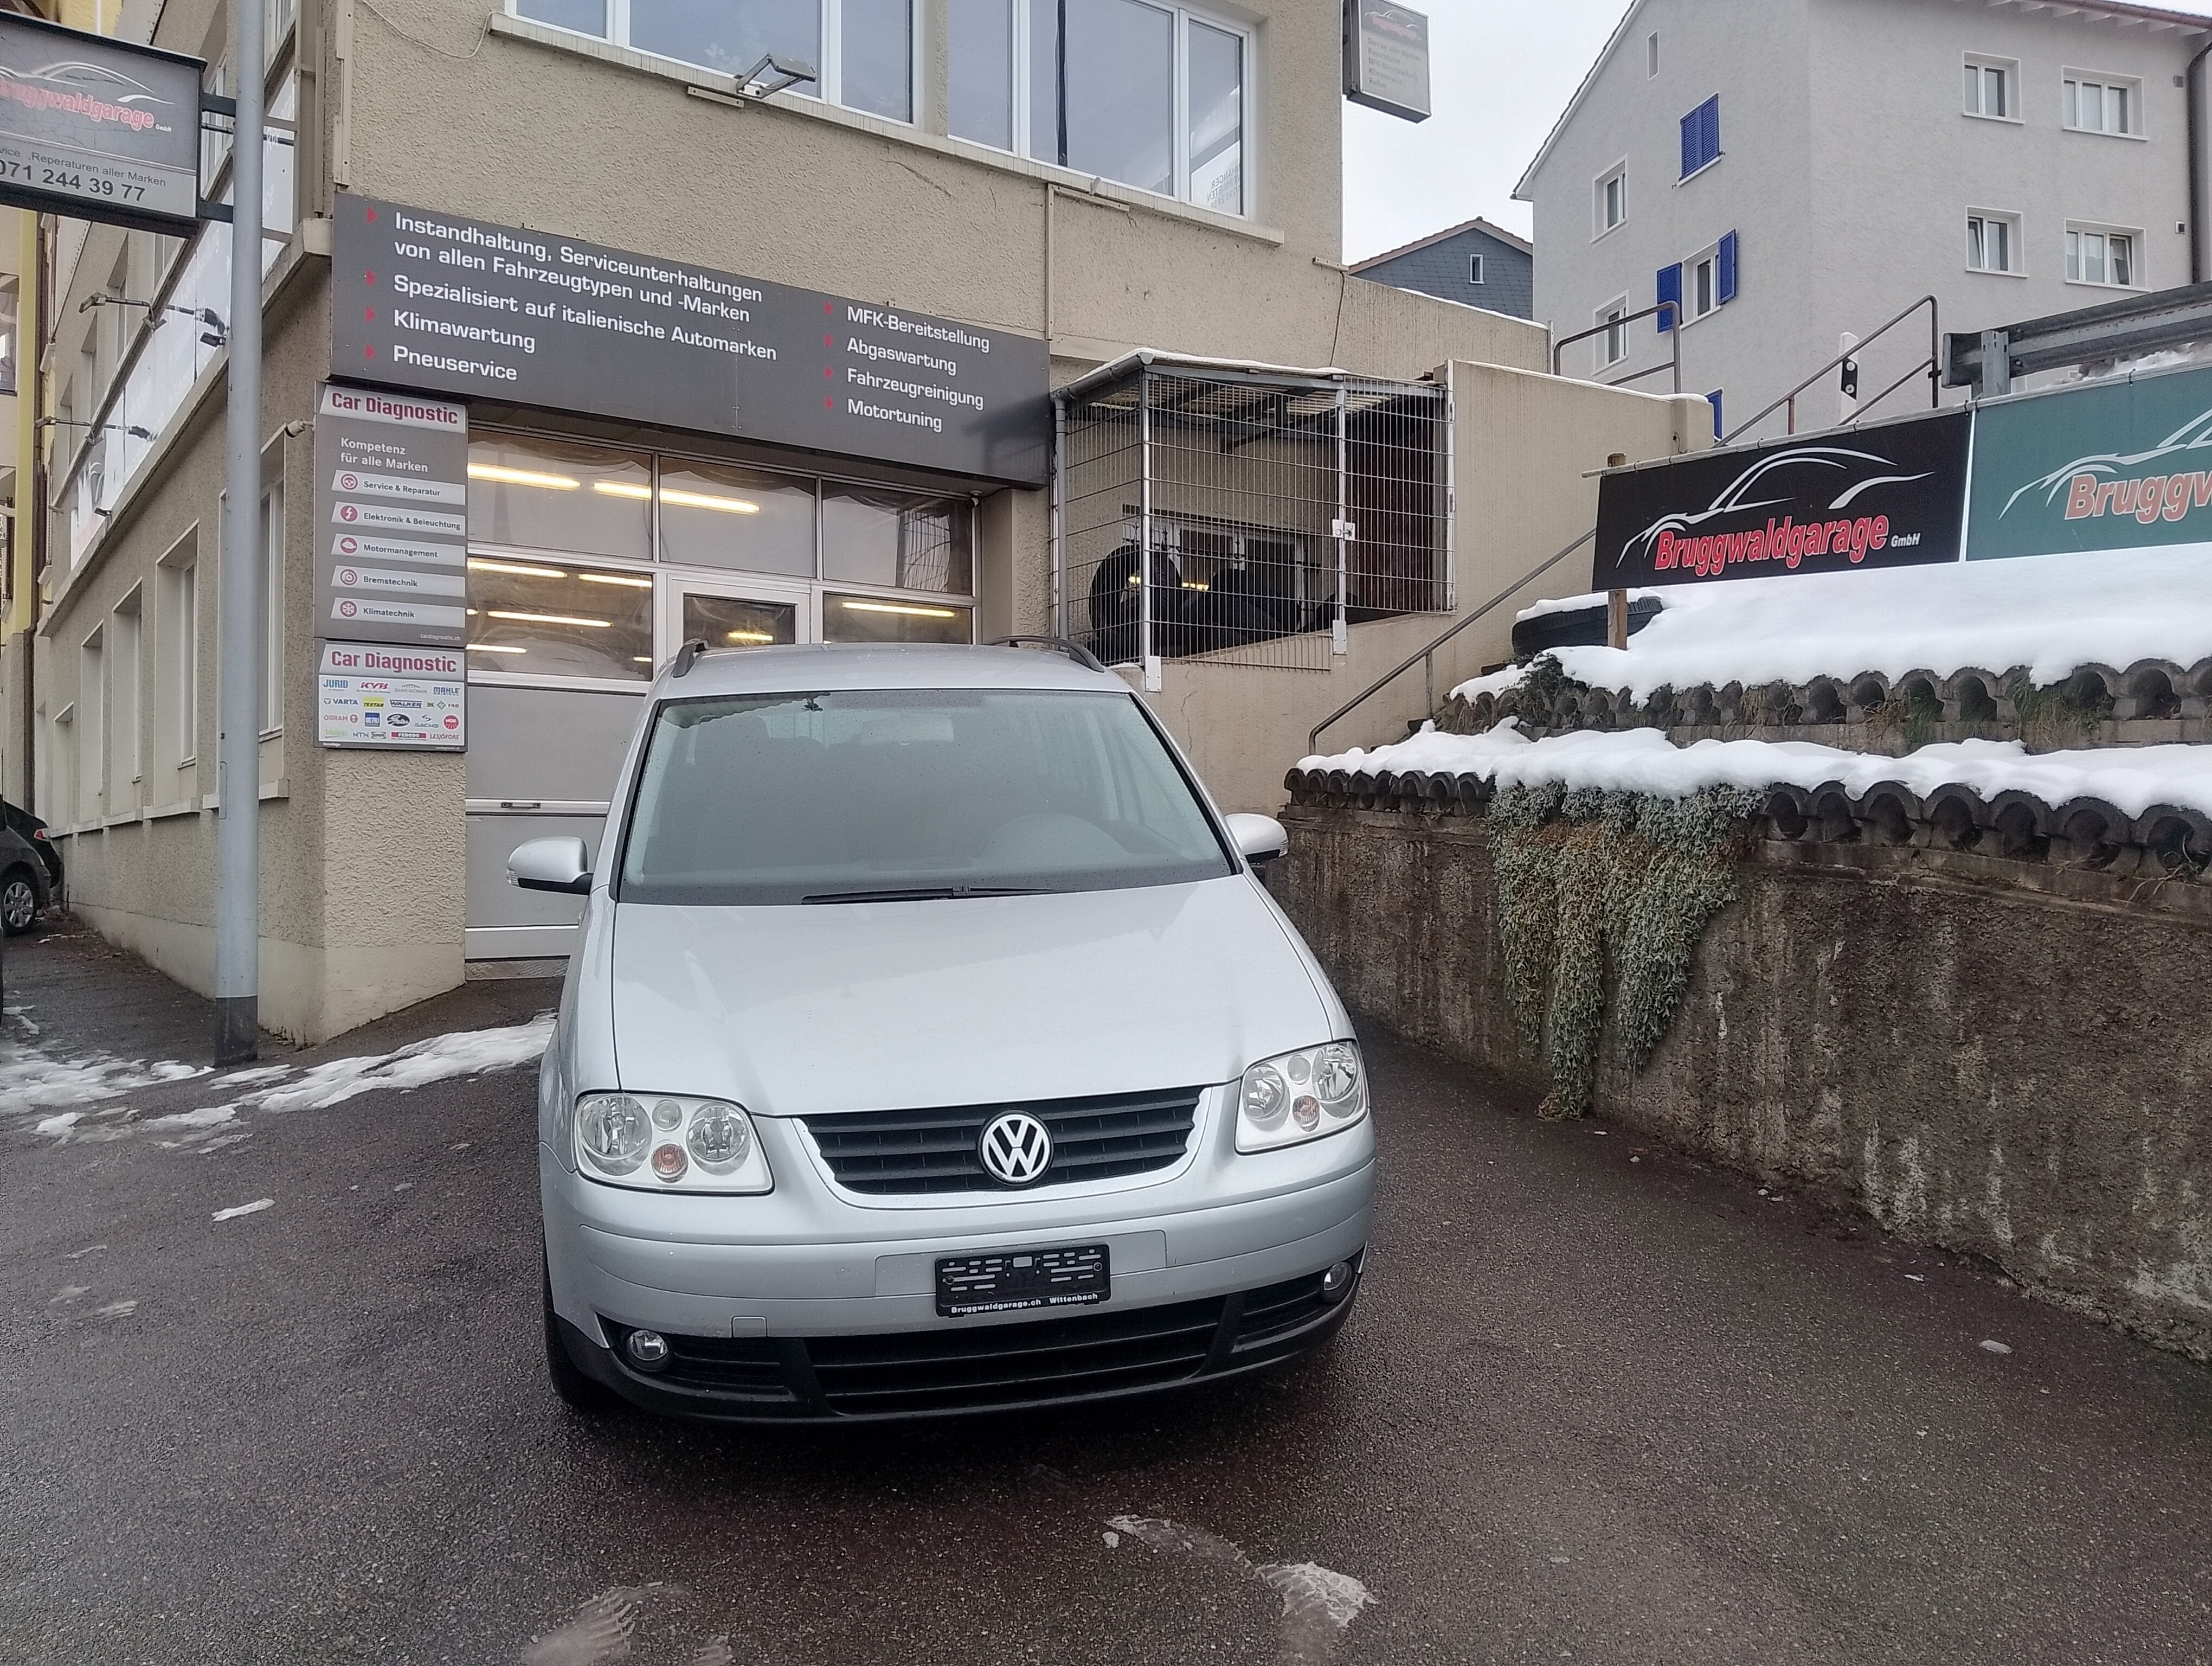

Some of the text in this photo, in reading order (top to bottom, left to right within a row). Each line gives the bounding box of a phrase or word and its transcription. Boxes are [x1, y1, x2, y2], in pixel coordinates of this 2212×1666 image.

[42, 169, 81, 190] 244
[88, 177, 113, 195] 39
[121, 183, 146, 202] 77
[102, 168, 124, 178] aller
[128, 171, 166, 187] Marken
[395, 212, 762, 303] Instandhaltung, Serviceunterhaltungen
[394, 242, 750, 323] von allen Fahrzeugtypen und -Marken
[394, 274, 777, 361] Spezialisiert auf italienische Automarken
[394, 309, 536, 354] Klimawartung
[847, 305, 990, 354] MFK-Bereitstellung
[394, 344, 517, 381] Pneuservice
[847, 337, 956, 376] Abgaswartung
[847, 368, 984, 411] Fahrzeugreinigung
[332, 392, 458, 424] Car Diagnostic
[847, 399, 942, 432] Motortuning
[340, 437, 406, 455] Kompetenz
[340, 452, 428, 473] für alle Marken
[363, 480, 393, 491] Service
[403, 485, 441, 496] Reparatur
[364, 512, 404, 523] Elektronik
[413, 518, 461, 530] Beleuchtung
[363, 544, 438, 558] Motormanagement
[1654, 514, 1920, 576] Bruggwaldgarage GmbH
[363, 576, 418, 587] Bremstechnik
[363, 607, 415, 618] Klimatechnik
[332, 651, 457, 673] Car Diagnostic
[323, 679, 348, 688] JURID
[390, 700, 422, 708] WALKER
[981, 1113, 1051, 1183] VW
[951, 1293, 1098, 1313] Bruggwaldgarage.ch Wittenbach
